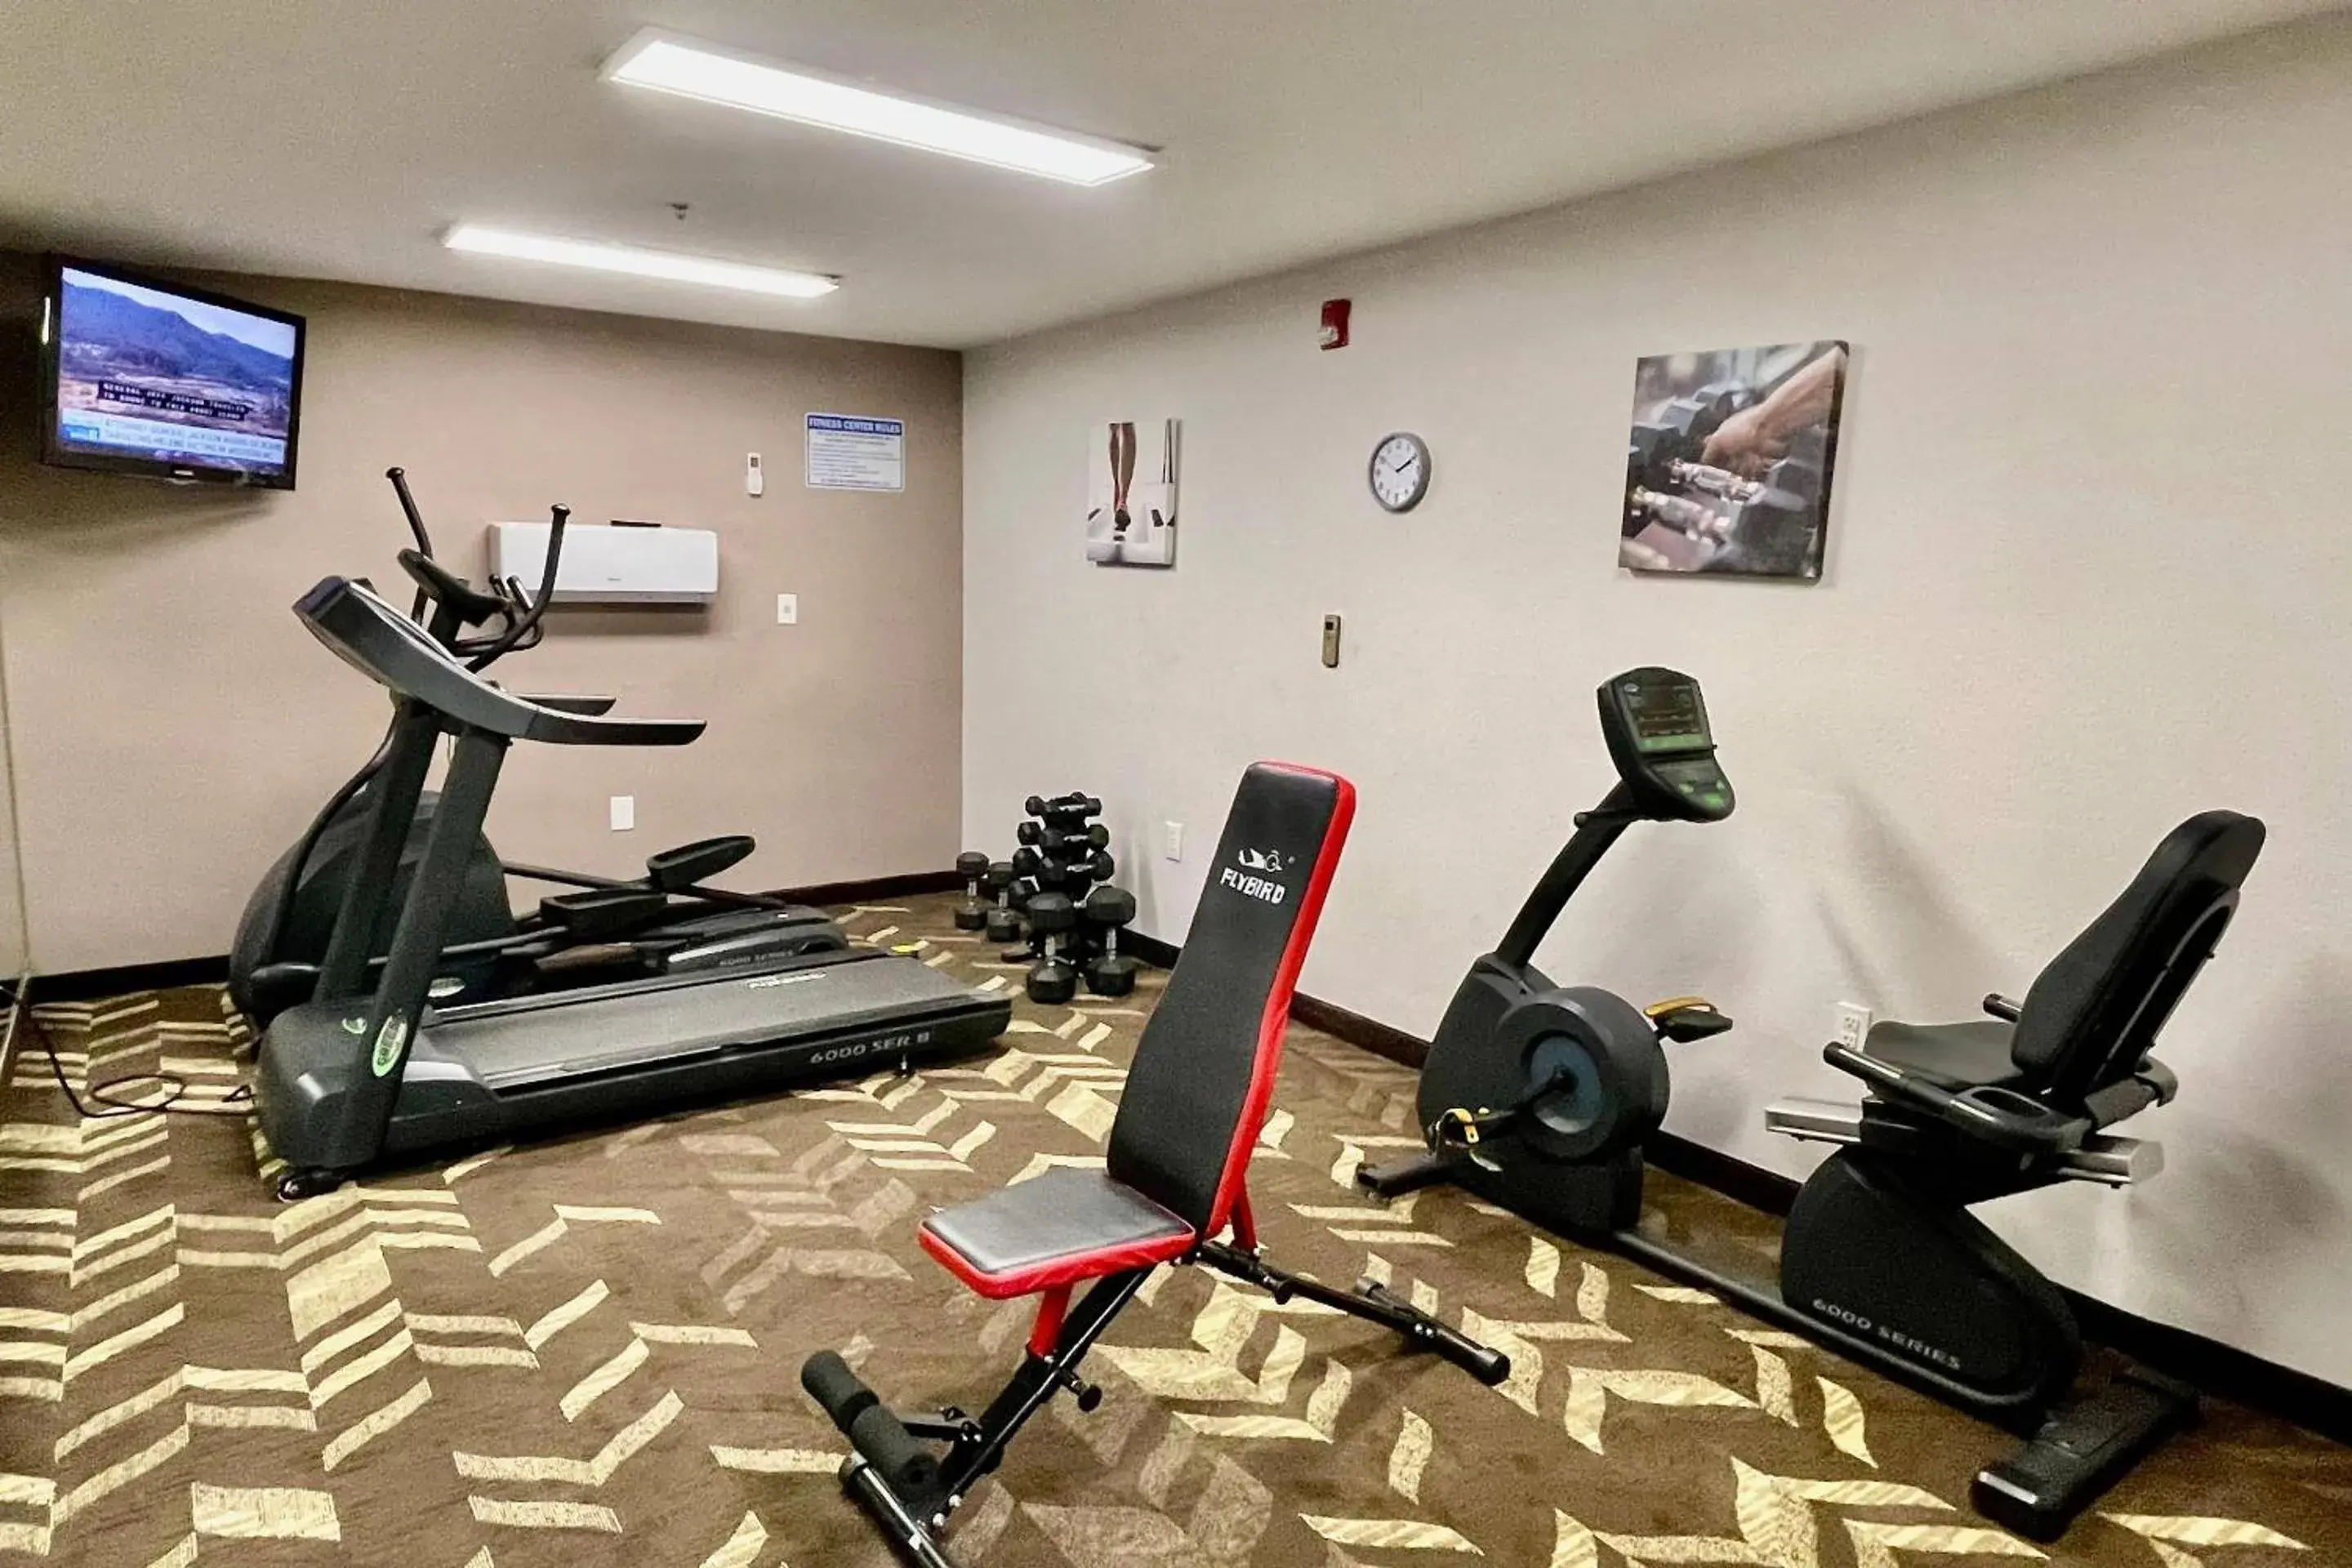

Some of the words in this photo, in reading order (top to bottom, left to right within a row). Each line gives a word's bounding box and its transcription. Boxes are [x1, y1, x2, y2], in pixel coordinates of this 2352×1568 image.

[843, 420, 874, 432] CENTER
[1220, 866, 1285, 904] FLYBIRD
[810, 1044, 866, 1064] 6000
[1812, 1298, 1872, 1330] 6000
[1879, 1325, 1960, 1370] SERIES
